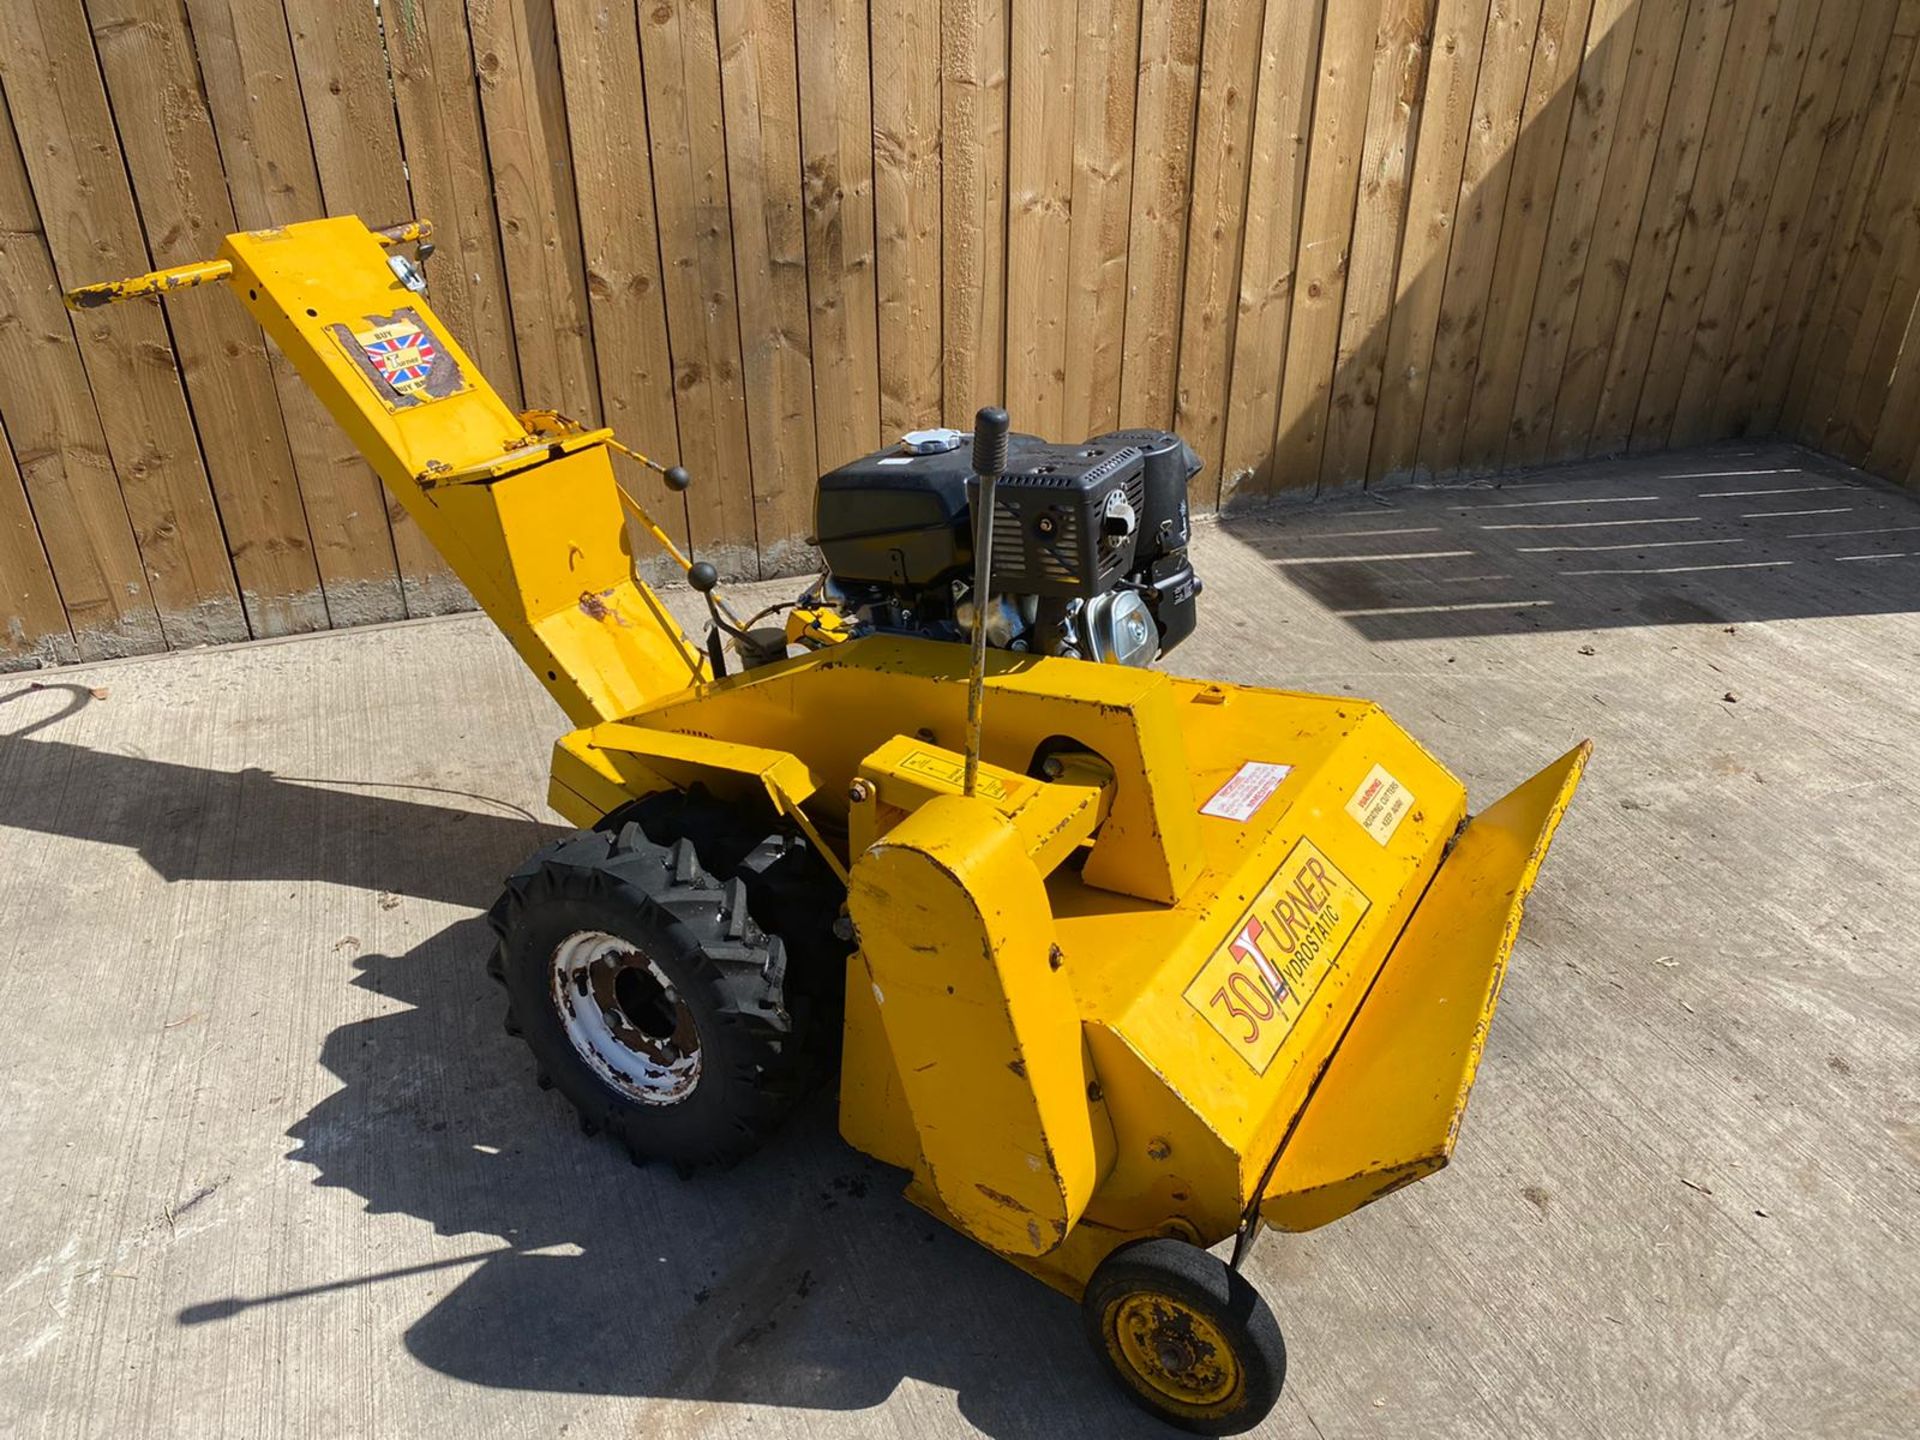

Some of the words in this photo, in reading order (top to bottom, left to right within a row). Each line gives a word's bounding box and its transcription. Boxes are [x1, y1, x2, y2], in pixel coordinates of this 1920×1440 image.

[374, 331, 393, 340] BUY
[386, 353, 420, 369] Turner
[1363, 803, 1384, 829] ROTATING
[1380, 781, 1399, 806] CUTTERS
[1210, 972, 1275, 1044] 30
